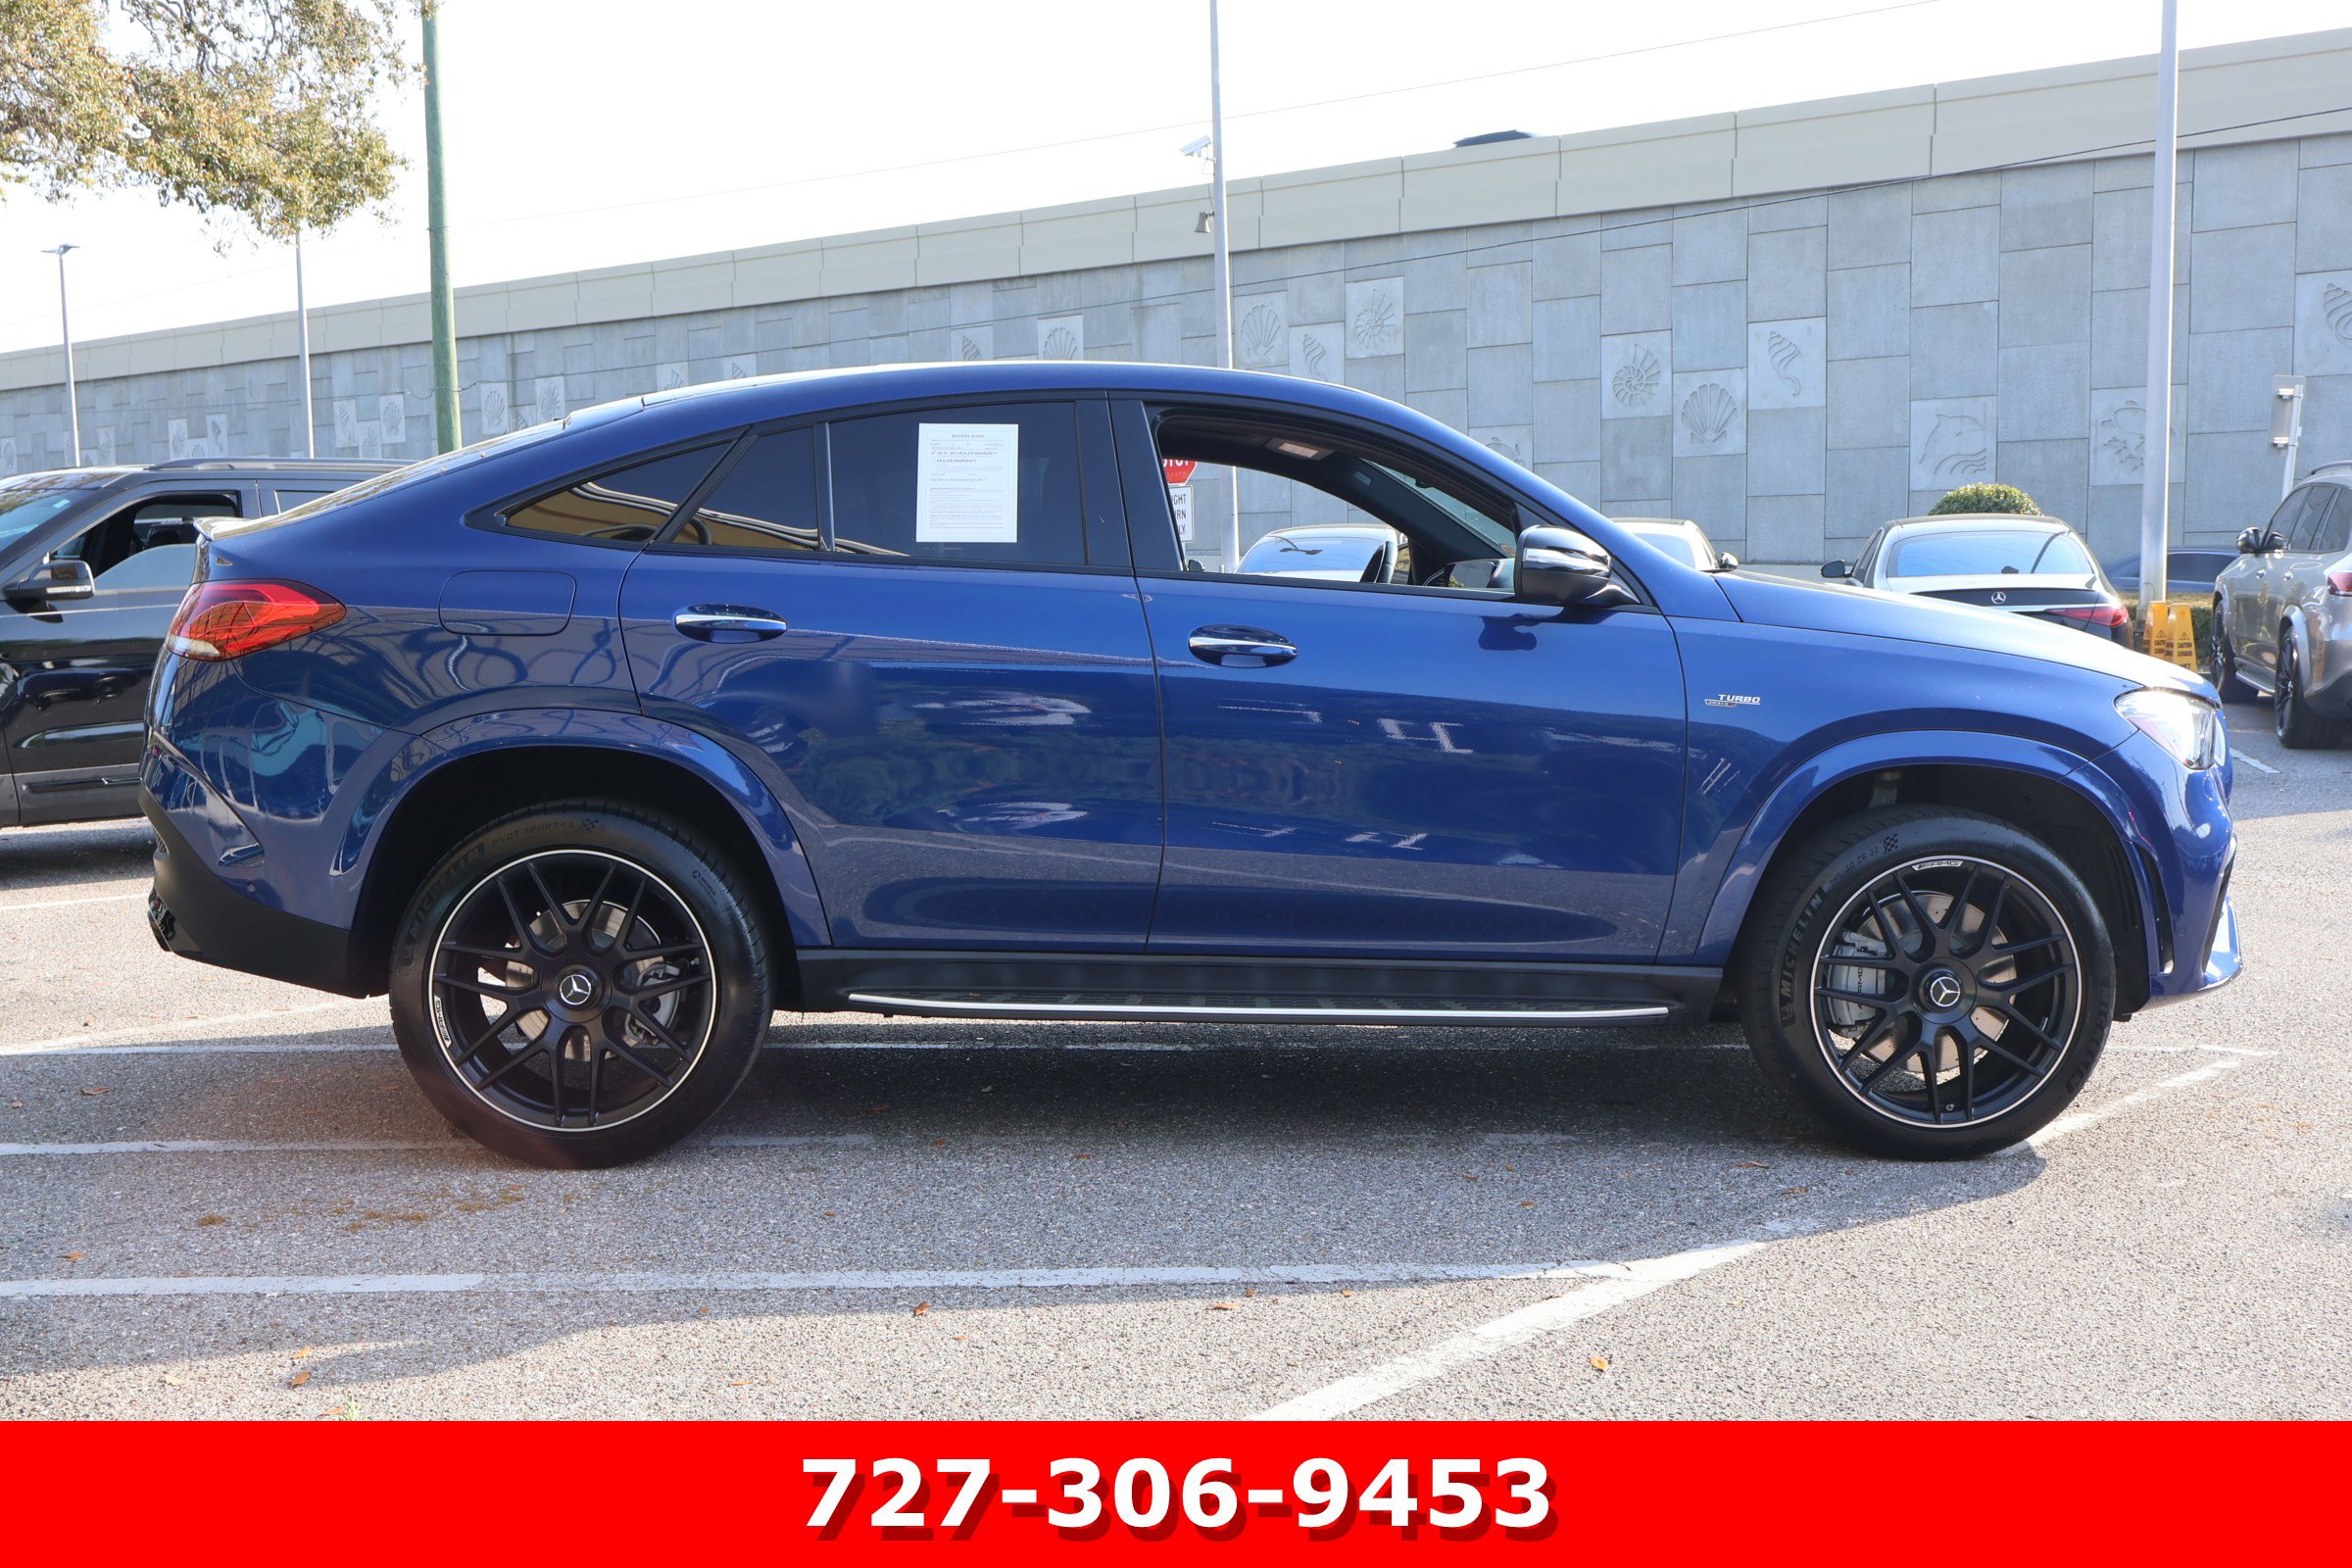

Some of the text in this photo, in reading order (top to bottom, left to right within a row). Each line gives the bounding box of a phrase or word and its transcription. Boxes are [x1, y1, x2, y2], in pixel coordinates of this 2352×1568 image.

[1718, 694, 1761, 704] TURBO
[492, 830, 519, 847] PILOT
[523, 821, 560, 836] SPORT
[1780, 889, 1825, 998] MICHELIN
